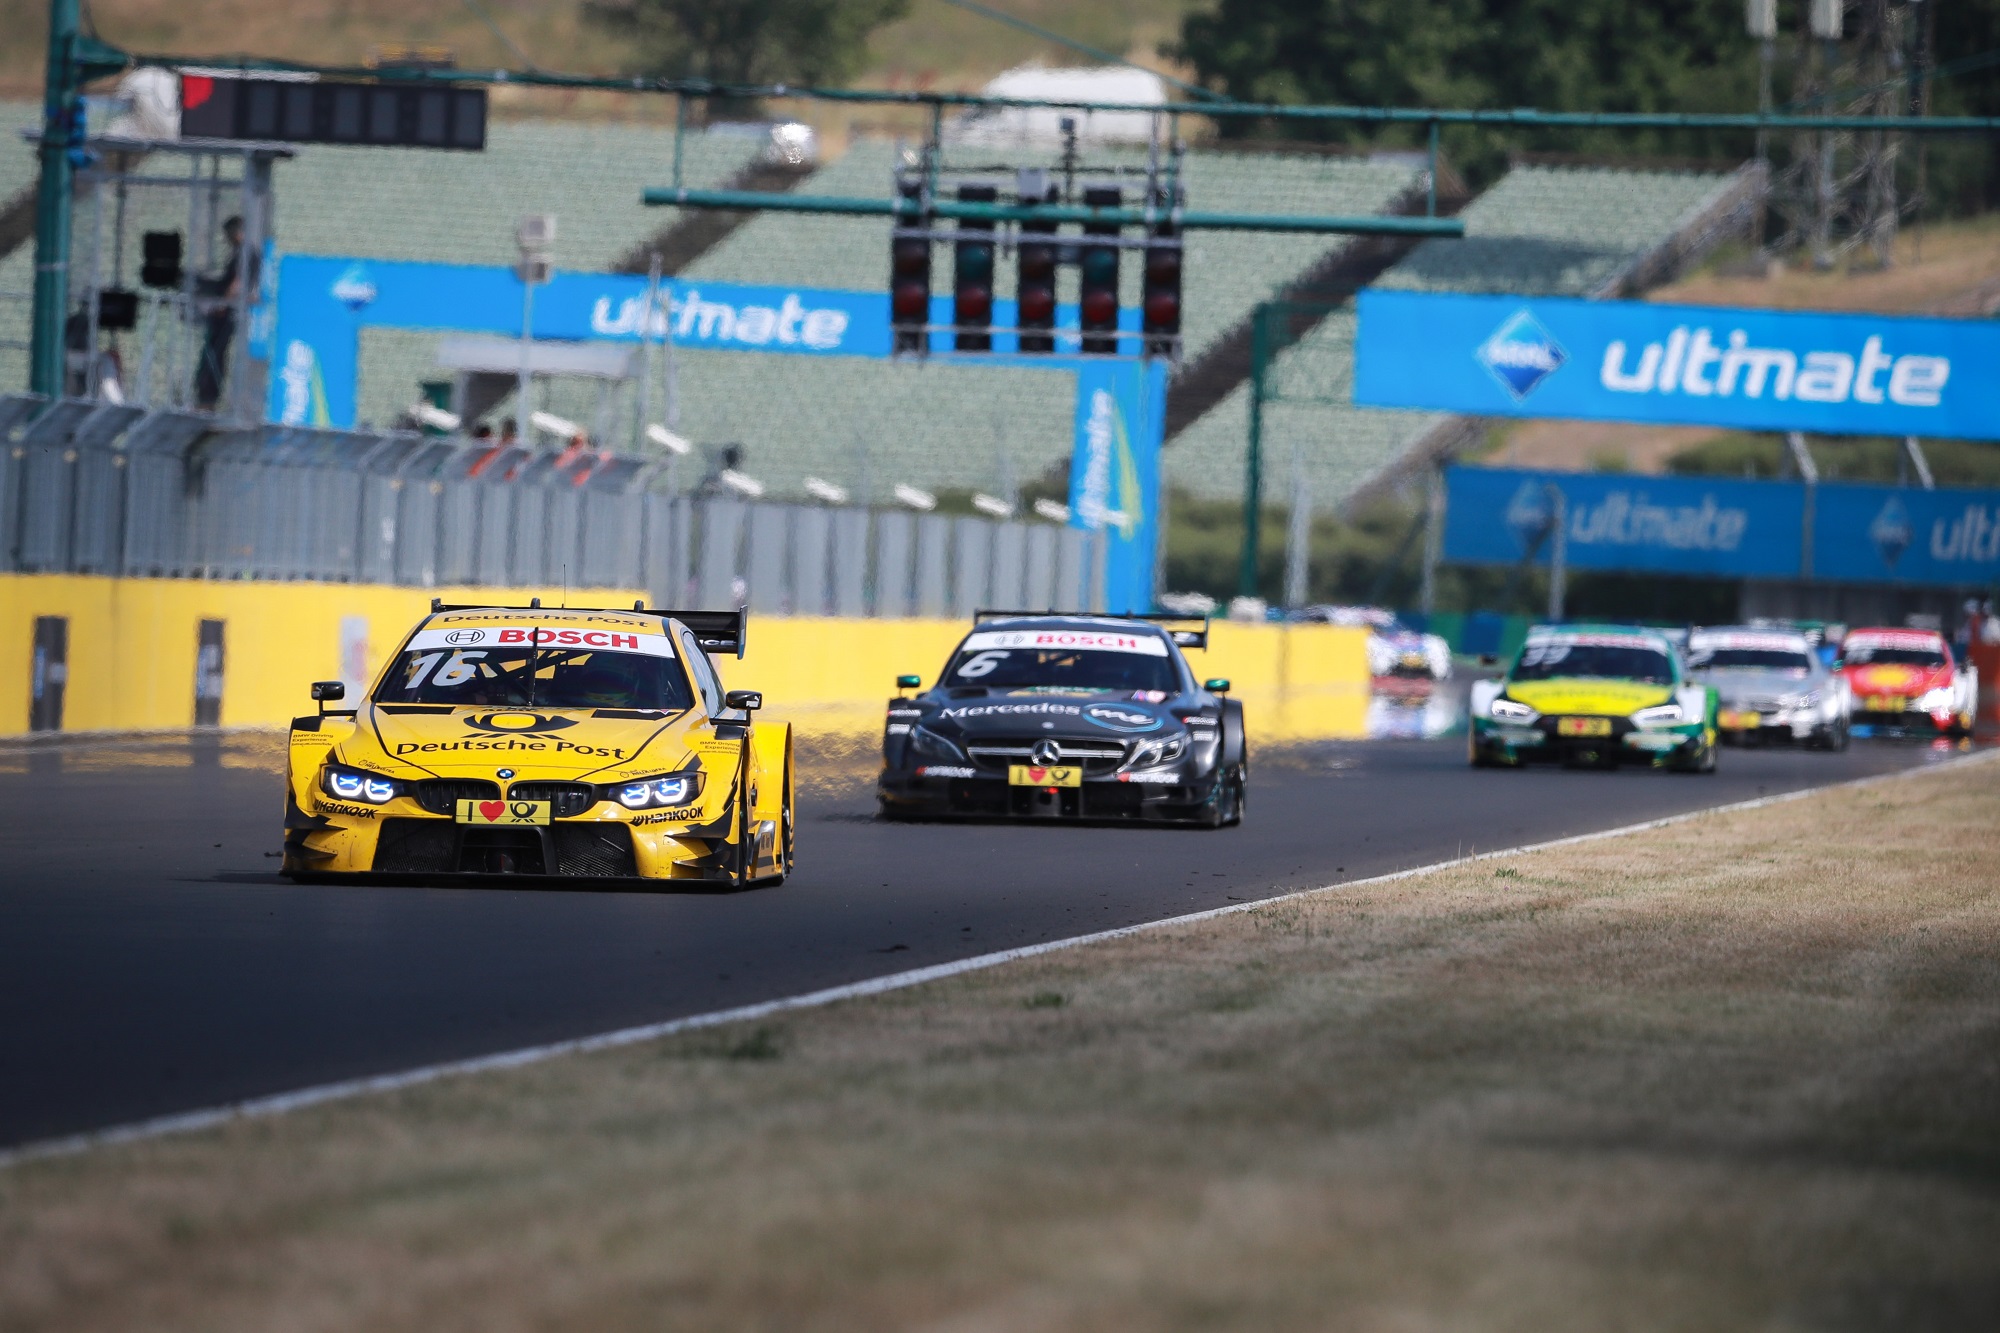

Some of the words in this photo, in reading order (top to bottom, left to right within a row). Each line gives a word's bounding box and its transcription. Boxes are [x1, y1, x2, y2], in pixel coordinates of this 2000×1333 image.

[1601, 326, 1951, 406] ultimate
[1571, 494, 1747, 550] ultimate
[444, 613, 578, 623] Deutsche
[587, 616, 648, 628] Post
[498, 630, 639, 649] BOSCH
[1036, 635, 1137, 648] BOSCH
[404, 651, 489, 689] 16
[957, 650, 1011, 678] 6
[938, 702, 1081, 720] Mercedes
[396, 740, 548, 755] Deutsche
[556, 742, 627, 760] Post
[468, 801, 474, 822] I
